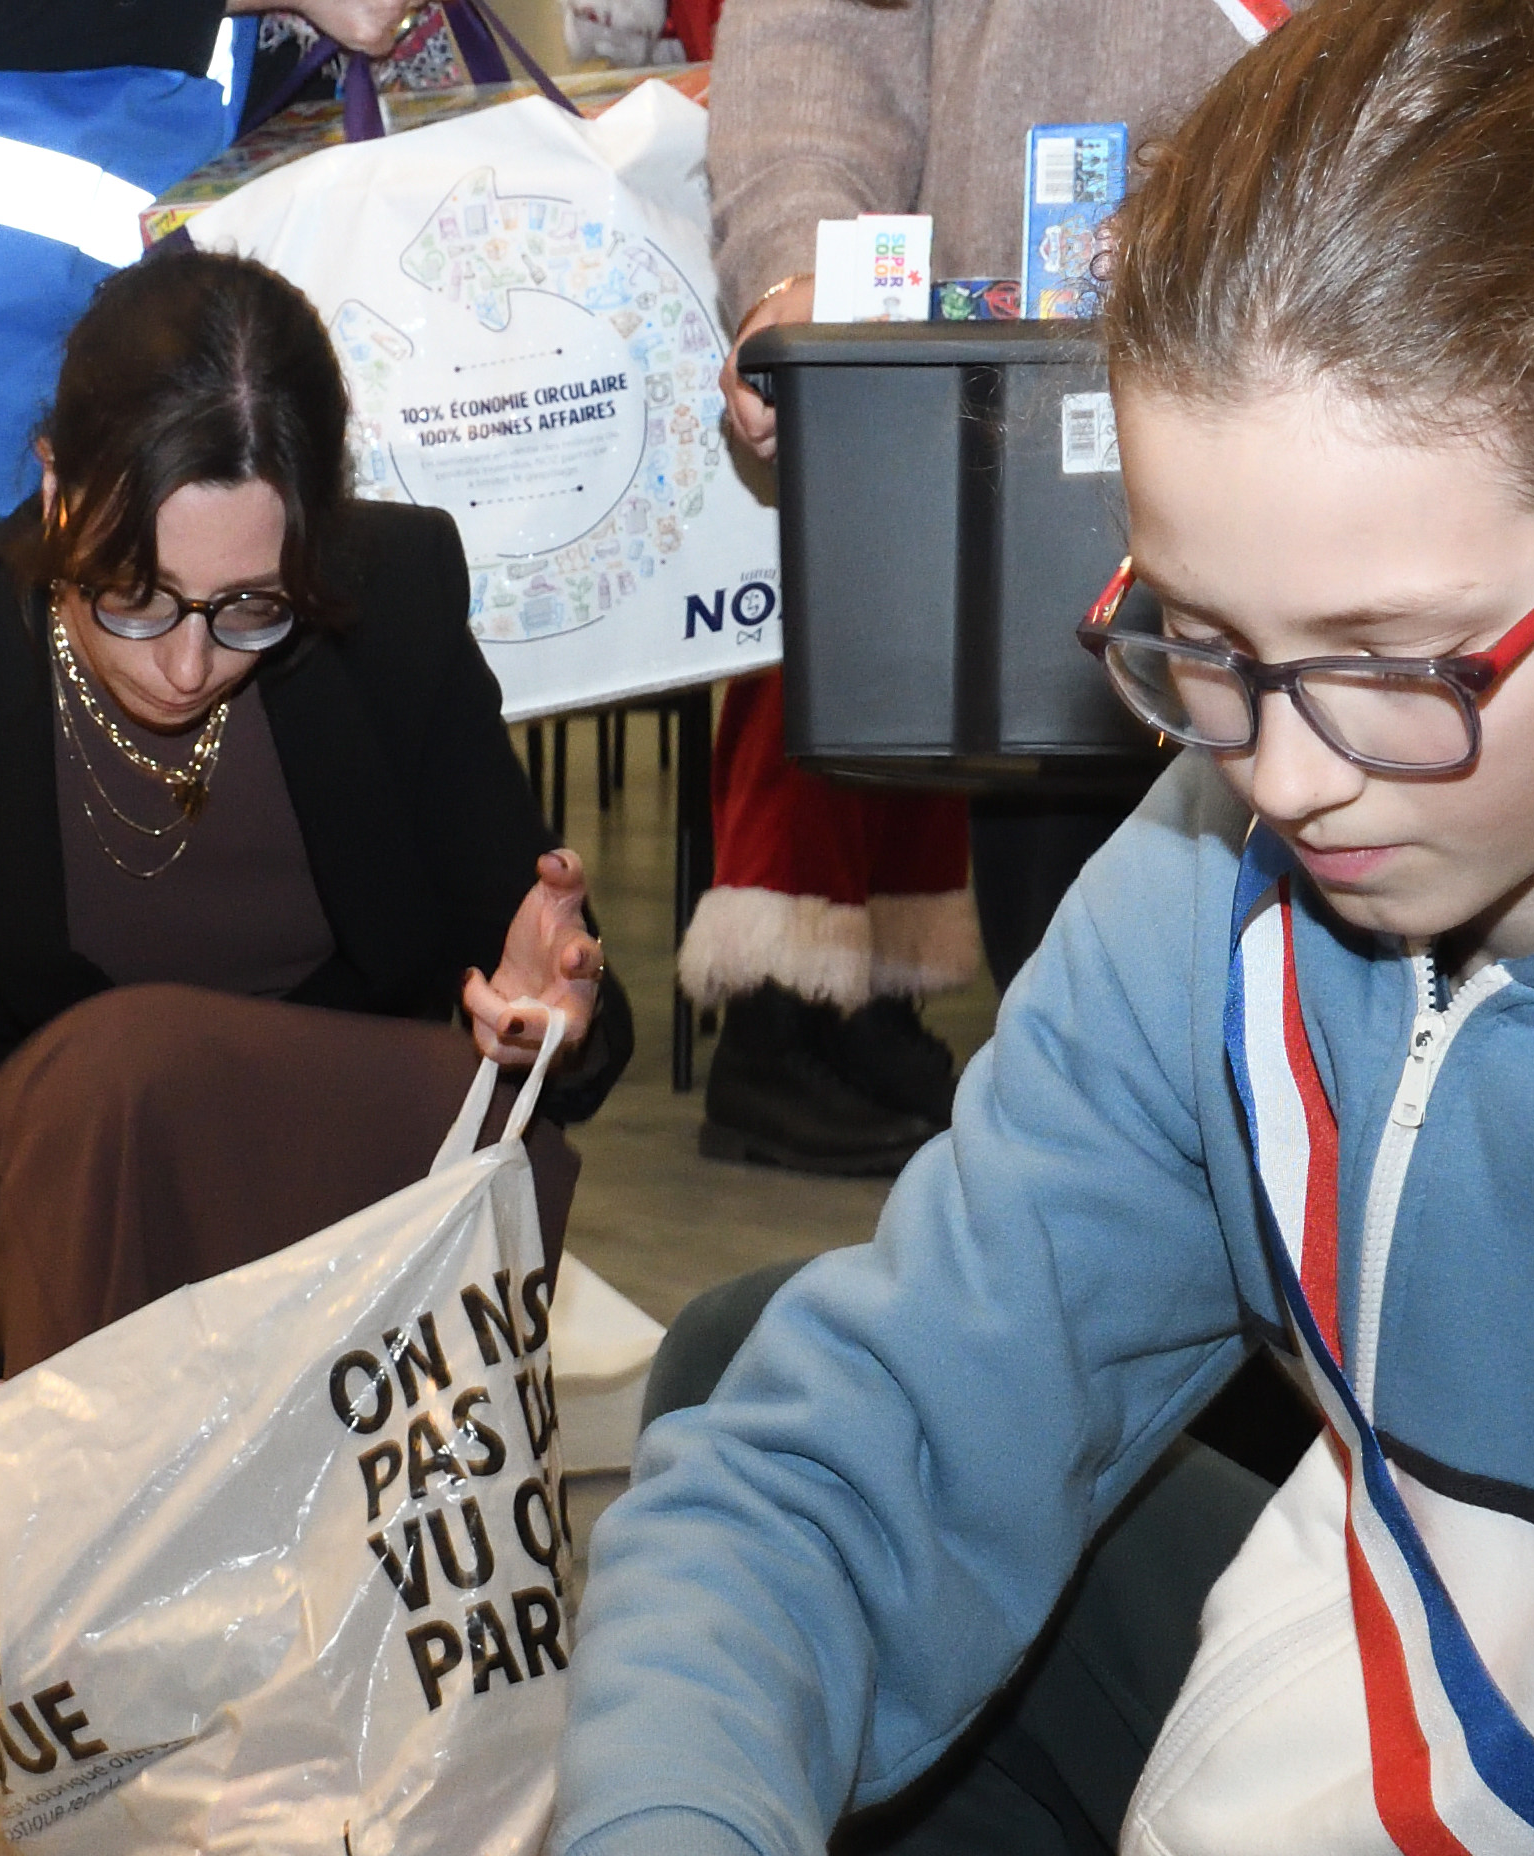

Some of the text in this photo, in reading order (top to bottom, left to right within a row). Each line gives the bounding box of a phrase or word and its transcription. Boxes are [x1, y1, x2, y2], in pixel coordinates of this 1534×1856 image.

[874, 233, 891, 288] COLOR
[889, 233, 906, 287] SUPER
[401, 373, 628, 424] 100% ÉCONOMIE CIRCULAIRE
[419, 401, 616, 446] 100% BONNES AFFAIRES
[683, 582, 782, 640] NO
[329, 1311, 452, 1435] ON
[356, 1386, 508, 1522] PAS
[367, 1495, 495, 1612] VU
[406, 1585, 569, 1712] PAR
